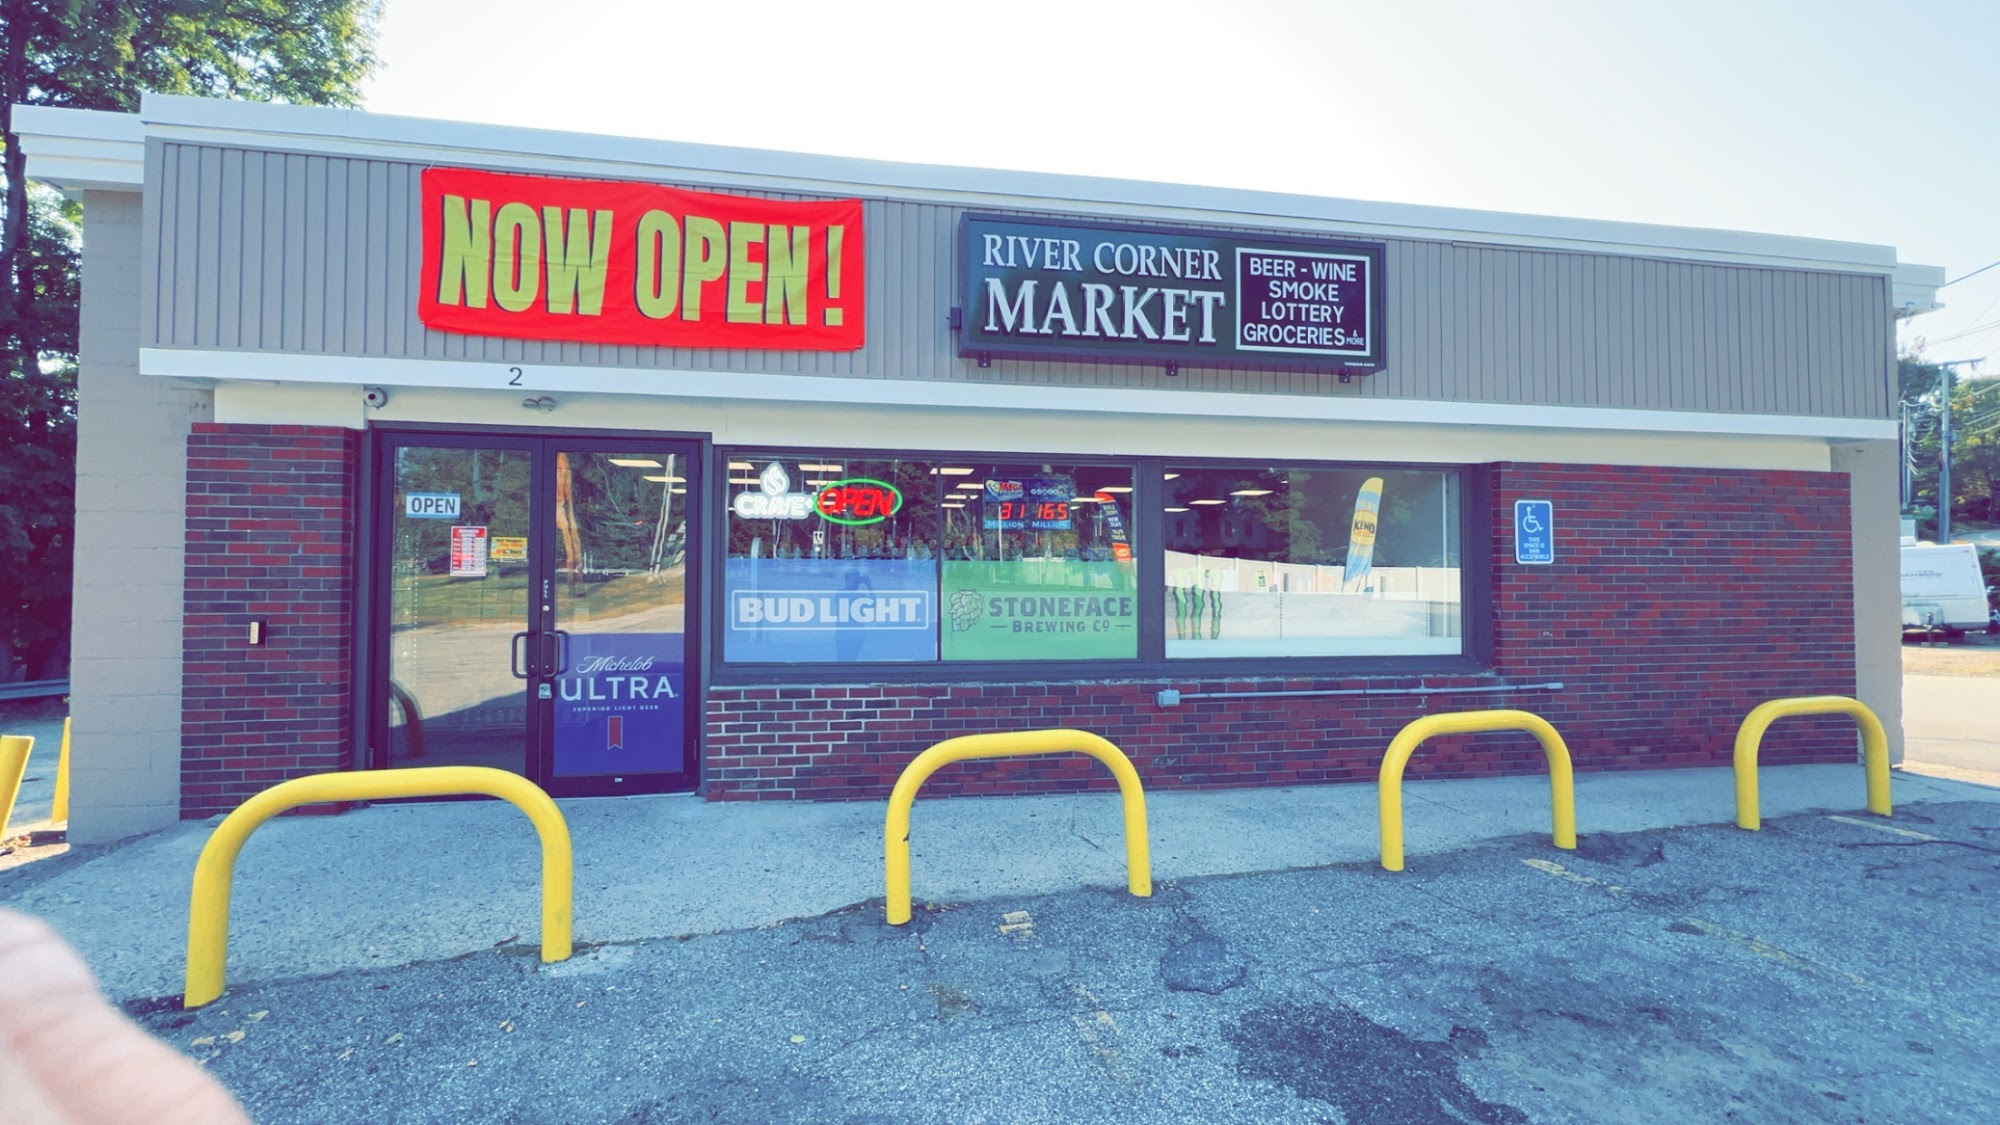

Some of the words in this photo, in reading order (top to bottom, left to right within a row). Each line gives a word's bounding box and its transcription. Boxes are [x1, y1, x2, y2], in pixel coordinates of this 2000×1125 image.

[437, 194, 614, 316] NOW
[983, 234, 1083, 271] RIVER
[1094, 242, 1222, 280] CORNER
[1250, 257, 1296, 278] BEER
[1311, 261, 1357, 282] WINE
[1268, 280, 1340, 302] SMOKE
[983, 277, 1226, 343] MARKET
[1261, 301, 1344, 323] LOTTERY
[1243, 323, 1345, 346] GROCERIES
[1346, 337, 1364, 346] MORE
[509, 367, 522, 386] 2
[411, 497, 455, 514] OPEN
[737, 495, 806, 515] CRAVE
[818, 487, 895, 516] OPEN
[1037, 502, 1068, 519] 165
[986, 520, 1024, 528] MILLION
[1031, 520, 1067, 528] MILLION
[1354, 520, 1376, 534] KENO
[739, 597, 815, 623] BUD
[819, 597, 921, 623] LIGHT
[989, 597, 1133, 617] STONEFACE
[1012, 620, 1086, 633] BREWING
[576, 655, 655, 673] Michelob
[560, 676, 675, 701] ULTRA
